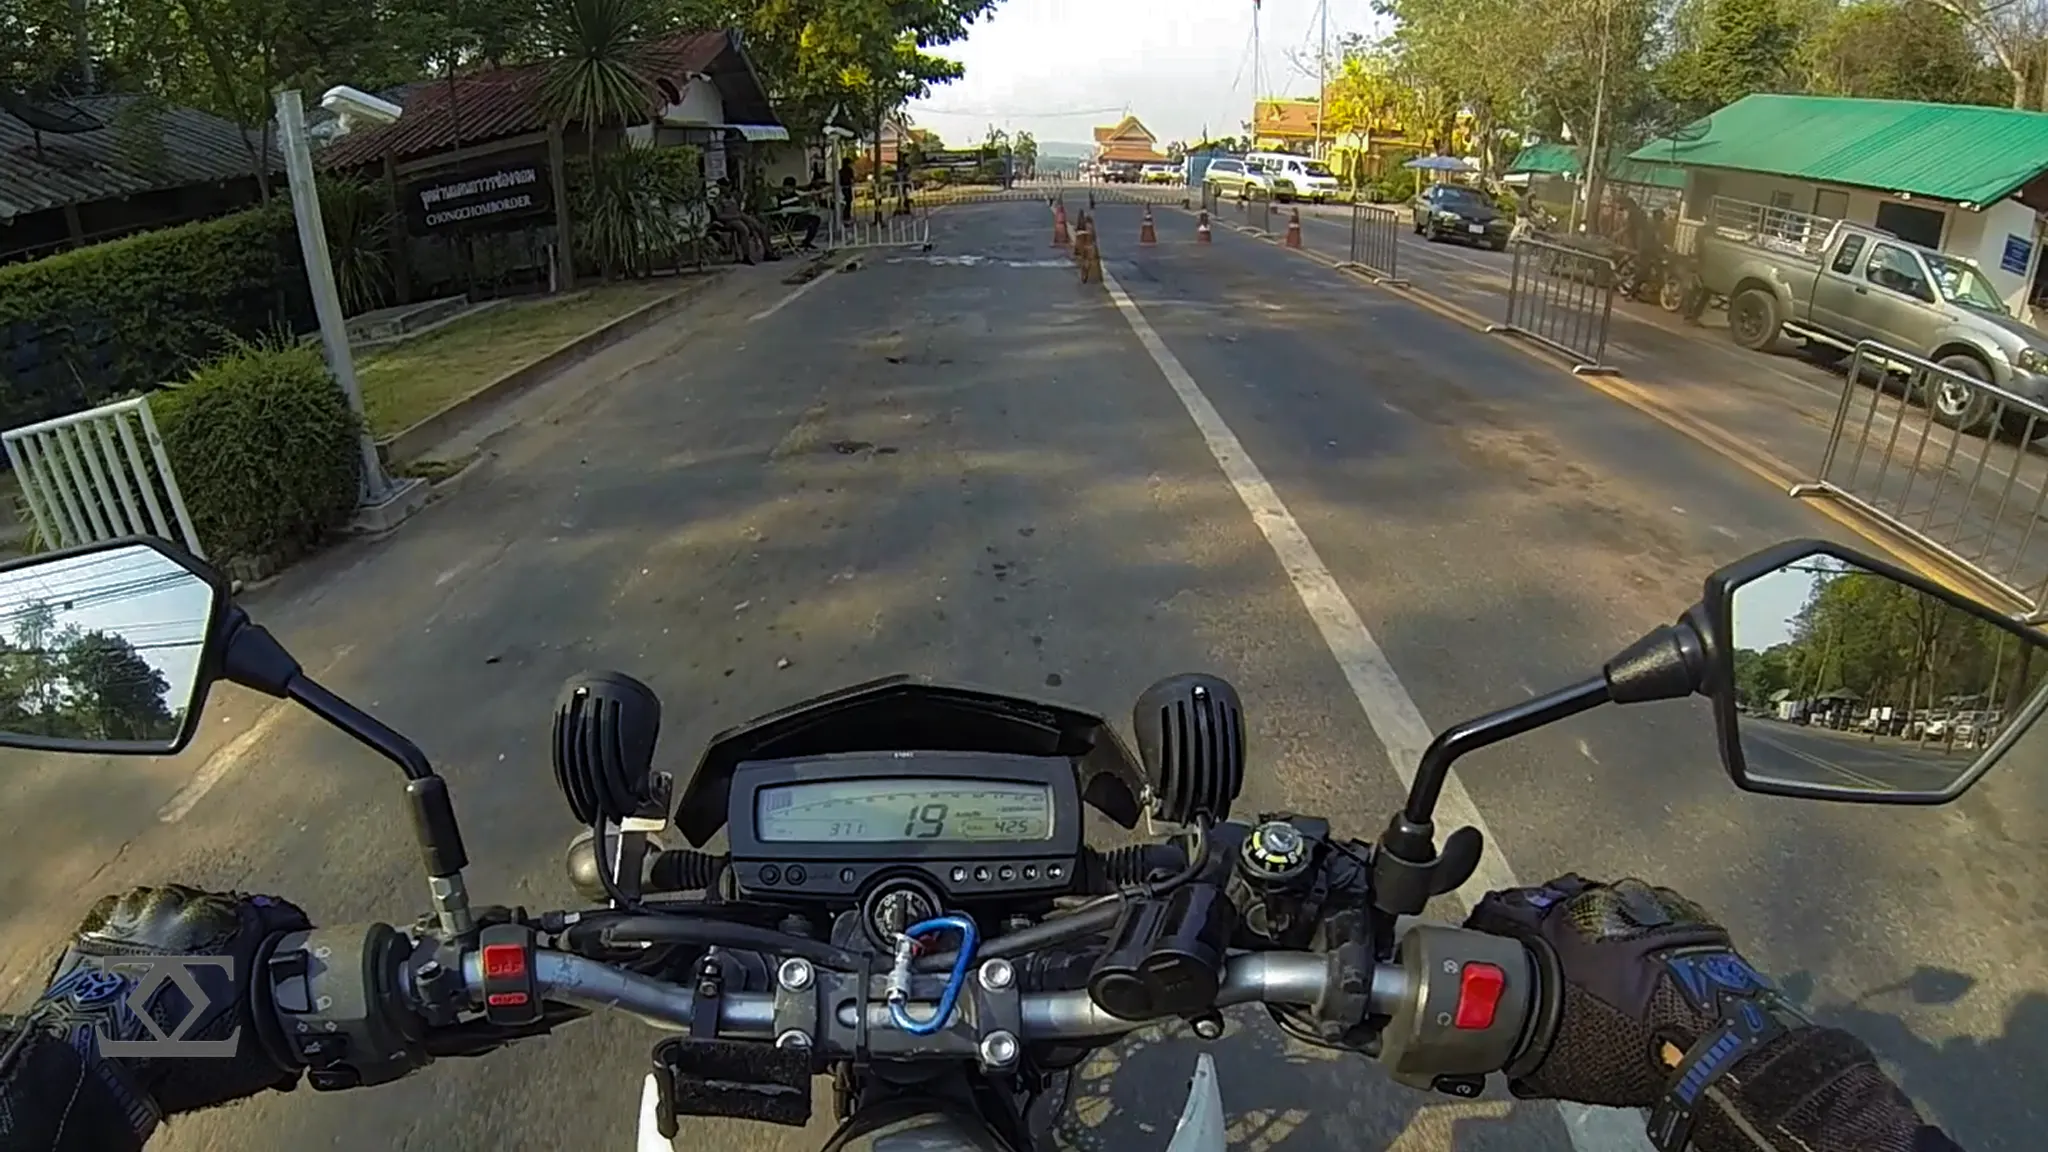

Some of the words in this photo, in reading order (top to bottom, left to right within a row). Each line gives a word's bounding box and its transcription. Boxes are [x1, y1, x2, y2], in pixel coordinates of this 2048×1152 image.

[904, 803, 948, 838] 19
[994, 820, 1028, 833] 425
[829, 823, 864, 836] 371
